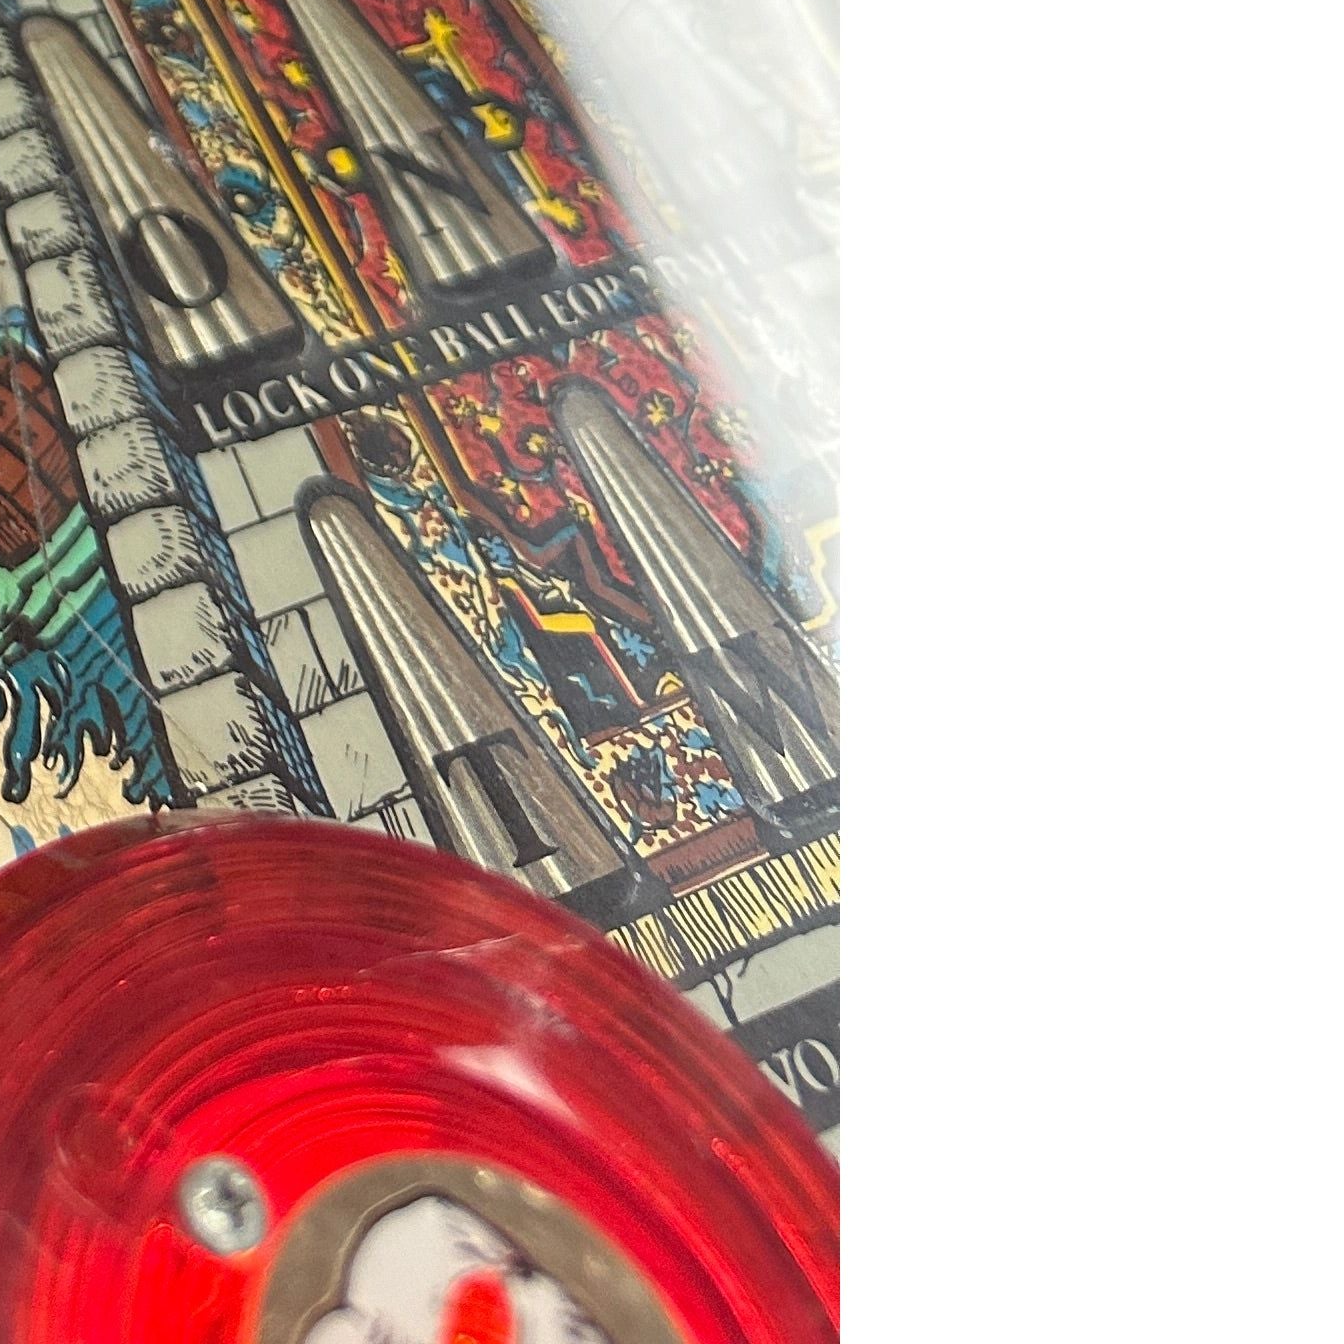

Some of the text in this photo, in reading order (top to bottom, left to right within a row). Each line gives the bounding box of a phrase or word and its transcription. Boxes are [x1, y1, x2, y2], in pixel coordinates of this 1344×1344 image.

[193, 369, 332, 445] LOCK
[328, 336, 433, 402] ONE
[429, 303, 549, 365] BALL
[430, 726, 560, 868] T
